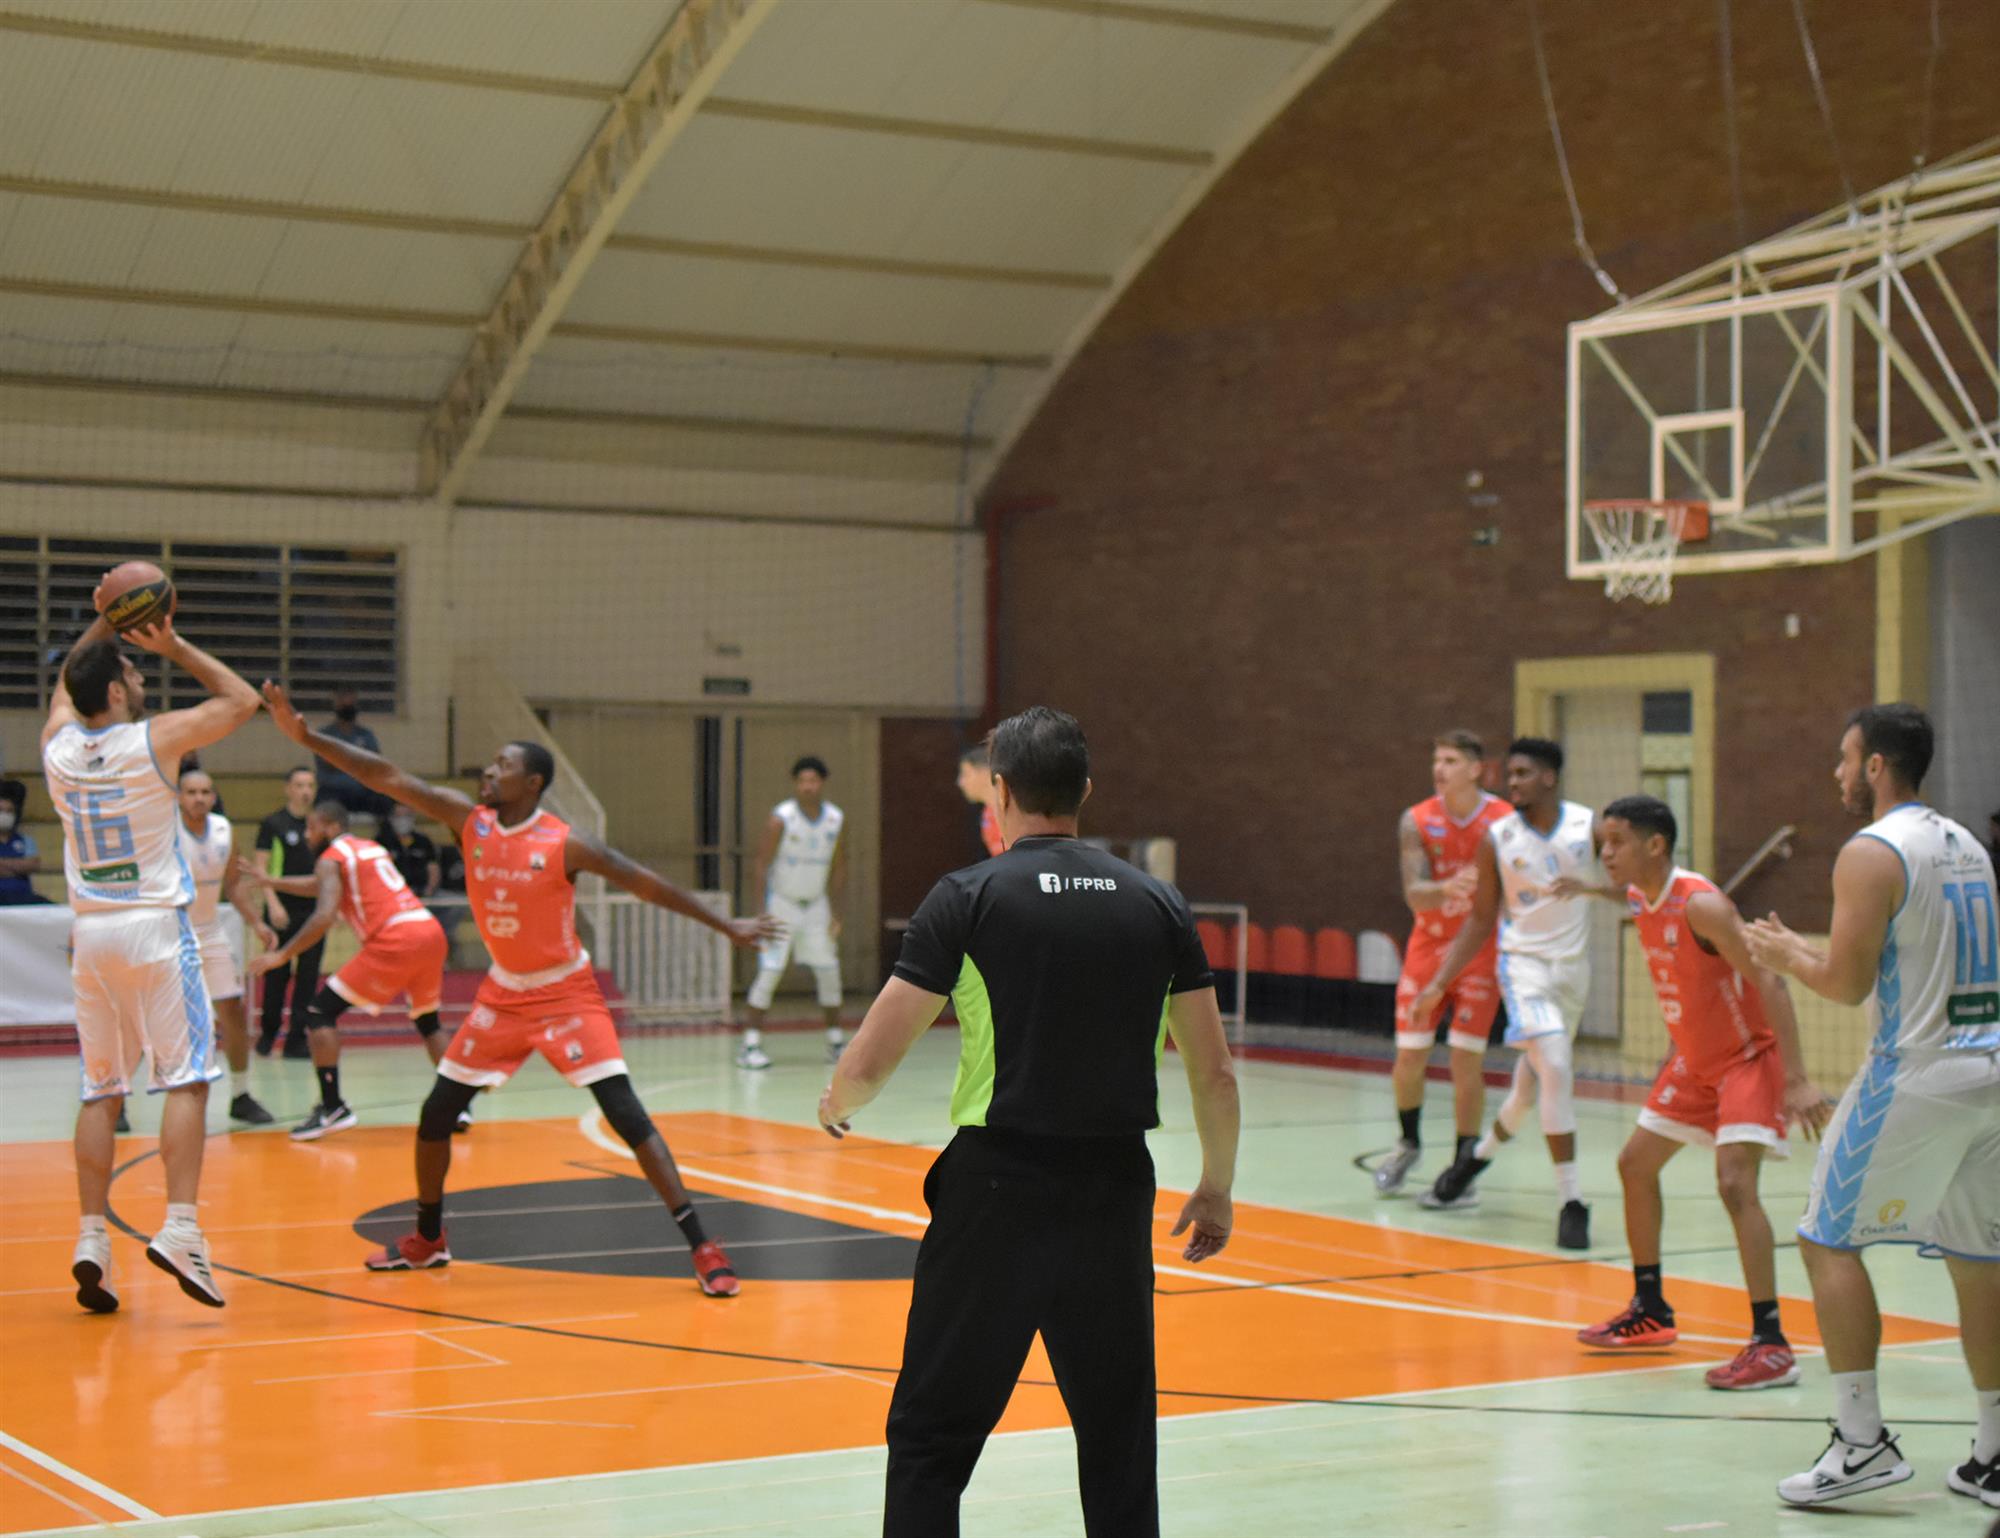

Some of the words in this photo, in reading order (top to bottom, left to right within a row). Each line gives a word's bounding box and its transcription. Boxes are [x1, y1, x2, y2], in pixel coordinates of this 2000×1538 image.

[65, 788, 134, 863] 16
[375, 857, 406, 893] 0
[1073, 877, 1118, 891] FPRB
[1942, 881, 1998, 985] 10
